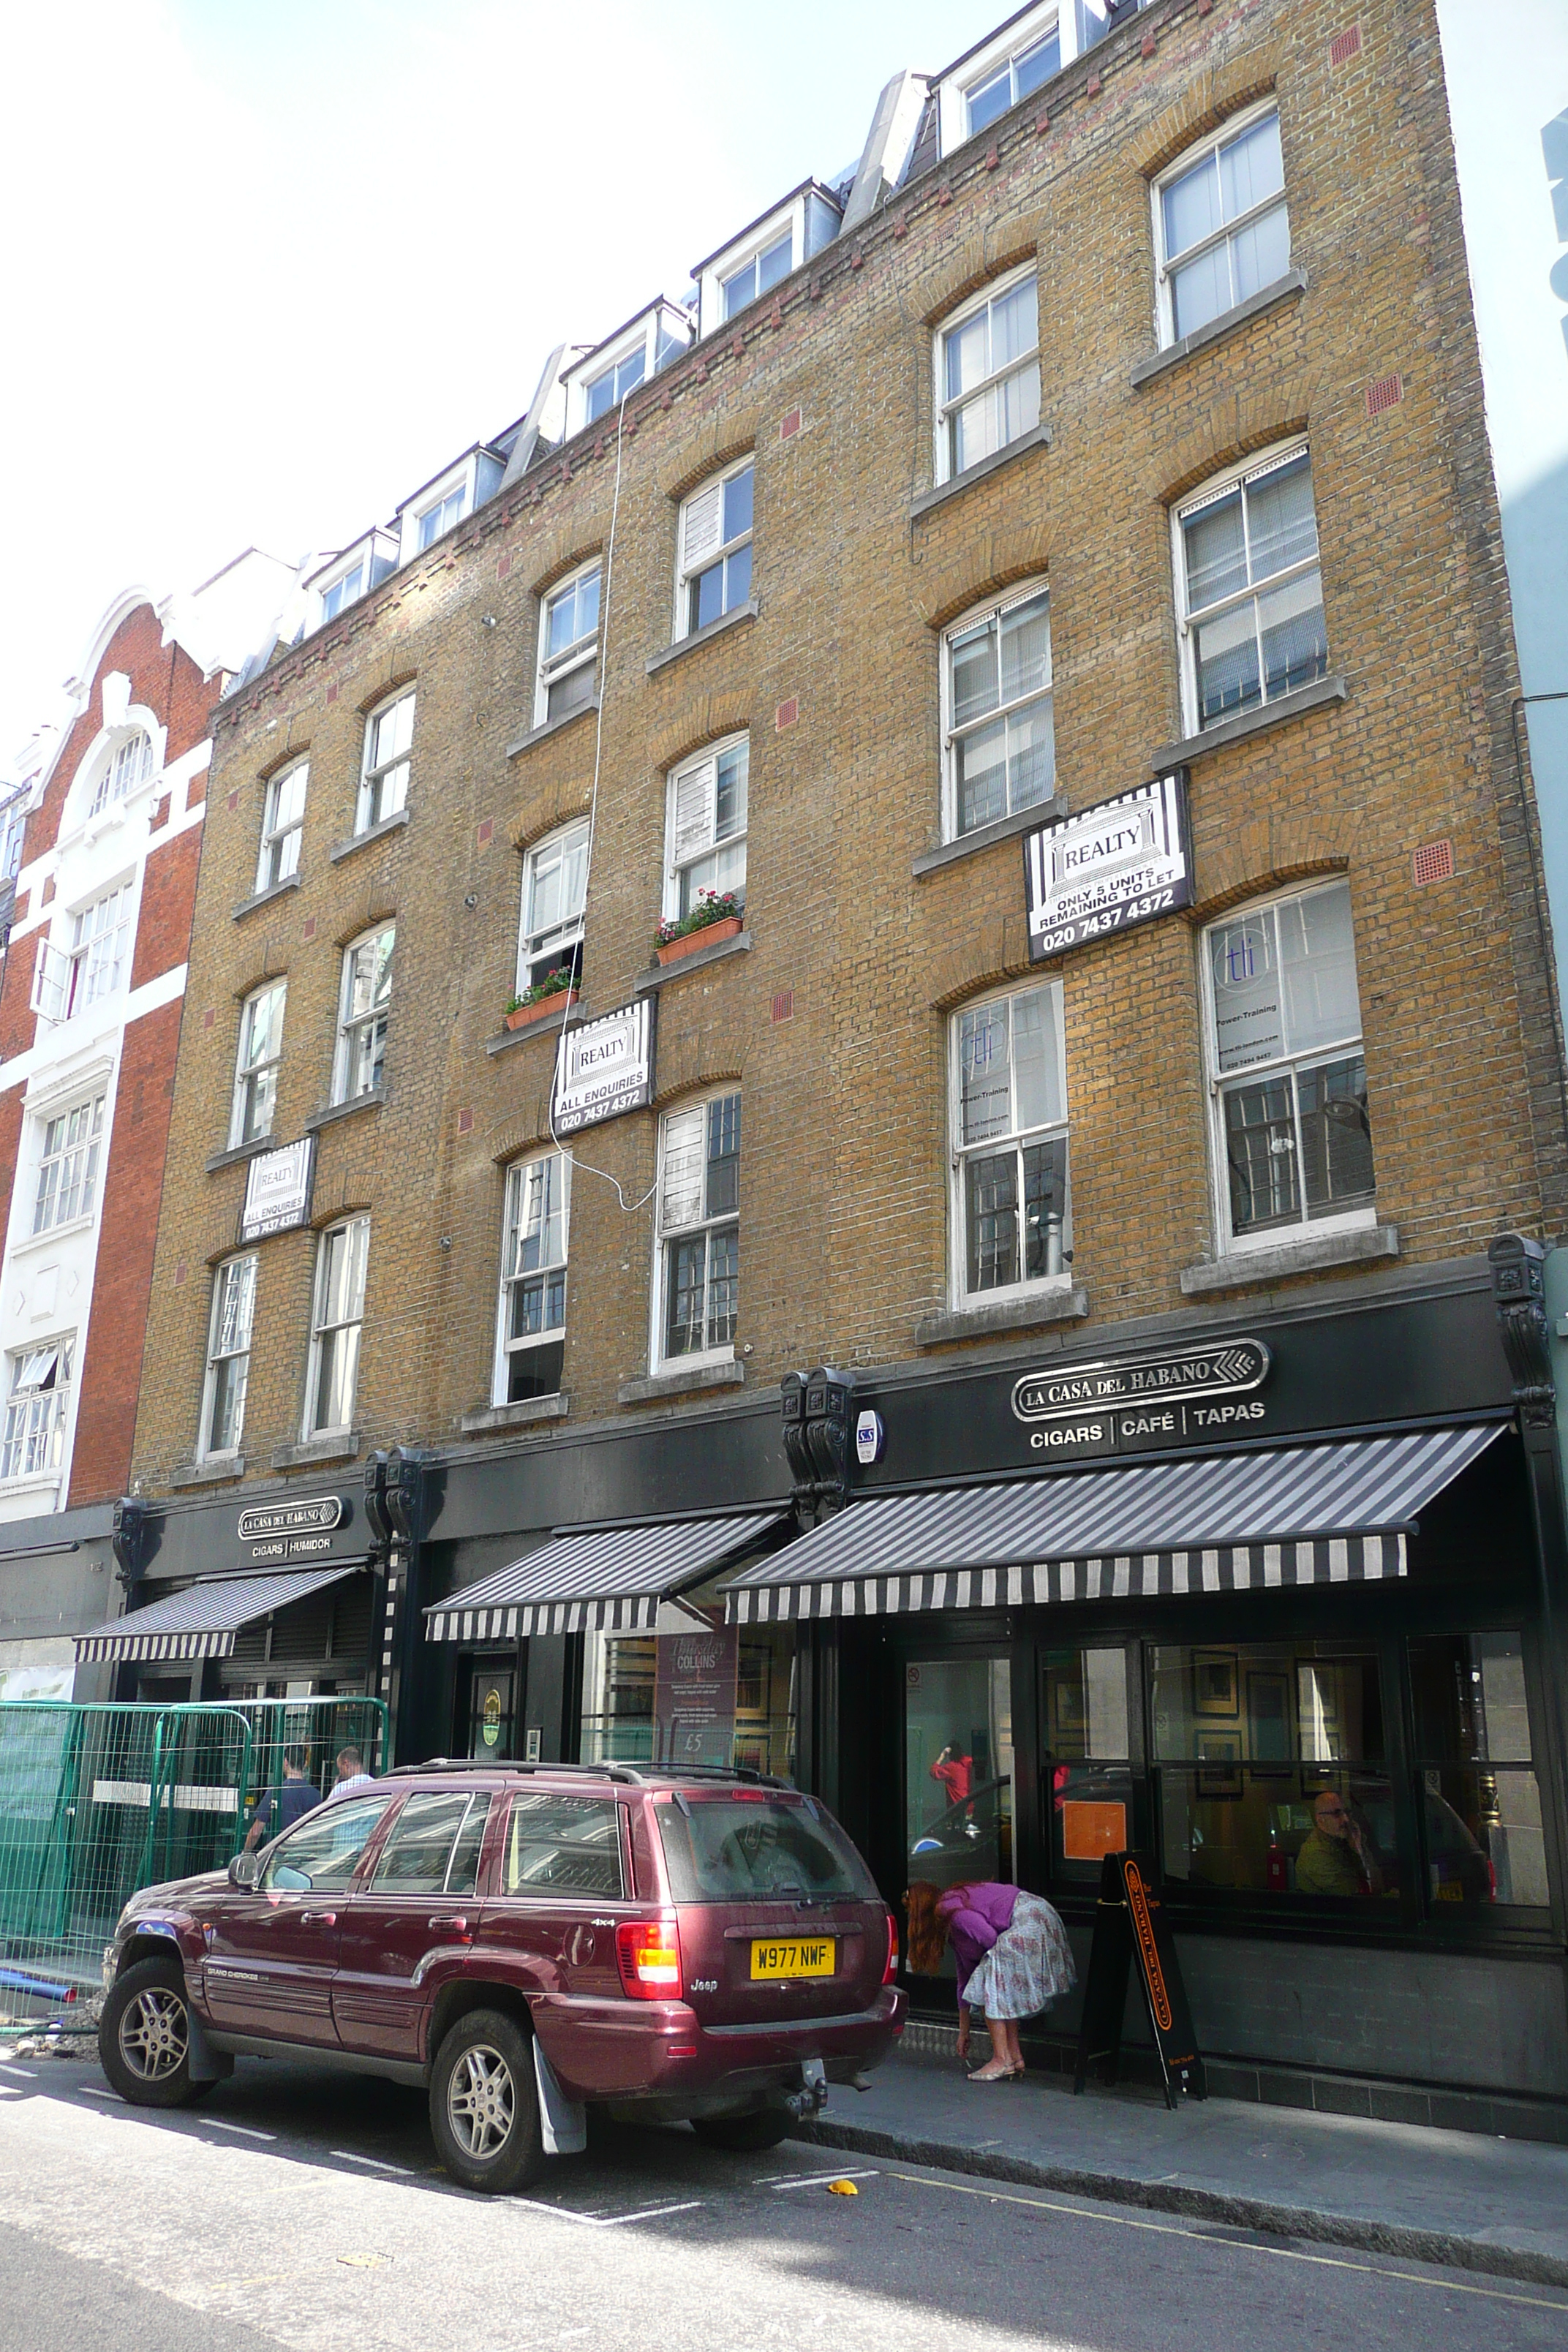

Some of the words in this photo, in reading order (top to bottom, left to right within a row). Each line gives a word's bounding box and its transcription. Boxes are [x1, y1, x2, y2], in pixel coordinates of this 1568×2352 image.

[1066, 826, 1140, 869] REALTY
[1058, 890, 1092, 911] ONLY
[1097, 886, 1105, 895] 5
[1110, 867, 1154, 890] UNITS
[1063, 884, 1092, 897] LONDON
[1094, 870, 1128, 886] PROPERTY
[1040, 892, 1117, 929] REMAINING
[1123, 883, 1142, 896] TO
[1148, 870, 1175, 888] LET
[1043, 927, 1074, 951] 020
[1079, 908, 1122, 937] 7437
[1127, 889, 1174, 919] 4372
[581, 1036, 627, 1066] REALTY
[560, 1097, 581, 1112] ALL
[584, 1071, 642, 1104] ENQUIRIES
[561, 1113, 581, 1131] 020
[584, 1101, 610, 1122] 7437
[611, 1090, 639, 1111] 4372
[262, 1166, 293, 1187] REALTY
[246, 1210, 259, 1223] ALL
[262, 1196, 302, 1218] ENQUIRIES
[246, 1226, 260, 1238] 020
[261, 1218, 279, 1234] 7437
[279, 1212, 299, 1227] 4372
[1026, 1392, 1044, 1407] LA
[1049, 1381, 1093, 1403] CASA
[1097, 1379, 1126, 1395] DEL
[1130, 1362, 1210, 1390] HABANO
[1030, 1425, 1103, 1448] CIGARS
[1122, 1414, 1175, 1436] CAFÉ
[1194, 1402, 1265, 1425] TAPAS
[244, 1521, 252, 1530] LA
[253, 1517, 271, 1529] CASA
[274, 1515, 284, 1526] DEL
[287, 1509, 319, 1524] HABANO
[252, 1544, 283, 1557] CIGARS
[290, 1539, 331, 1553] HUMIDOR
[677, 1654, 715, 1669] COLLINS
[591, 1918, 615, 1927] 4x4
[758, 1947, 796, 1969] W977
[801, 1945, 826, 1966] NWF
[690, 1979, 718, 1992] Jeep
